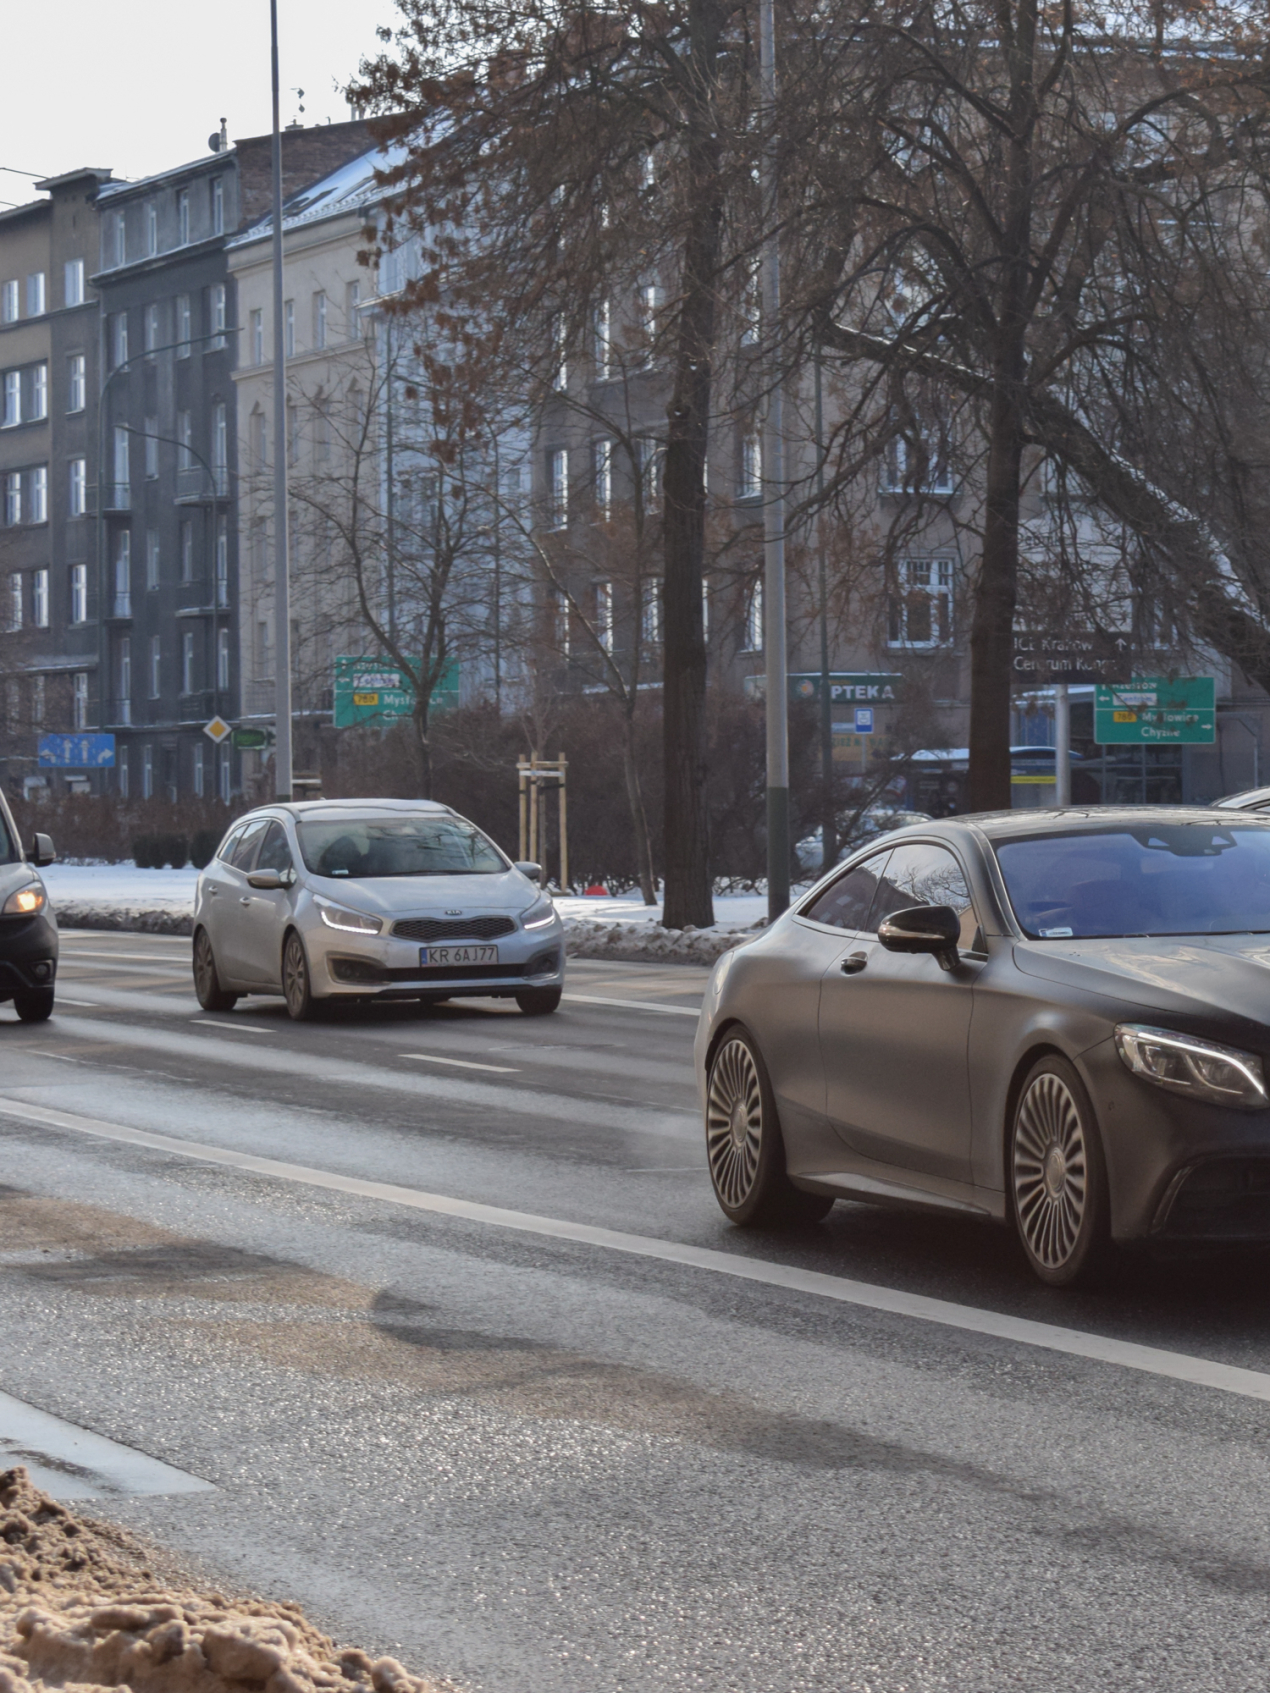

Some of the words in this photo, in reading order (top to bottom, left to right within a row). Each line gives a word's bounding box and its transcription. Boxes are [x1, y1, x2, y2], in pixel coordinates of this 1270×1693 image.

[818, 684, 896, 700] PTEKA
[428, 949, 449, 963] KR
[454, 947, 495, 962] 6AJ77
